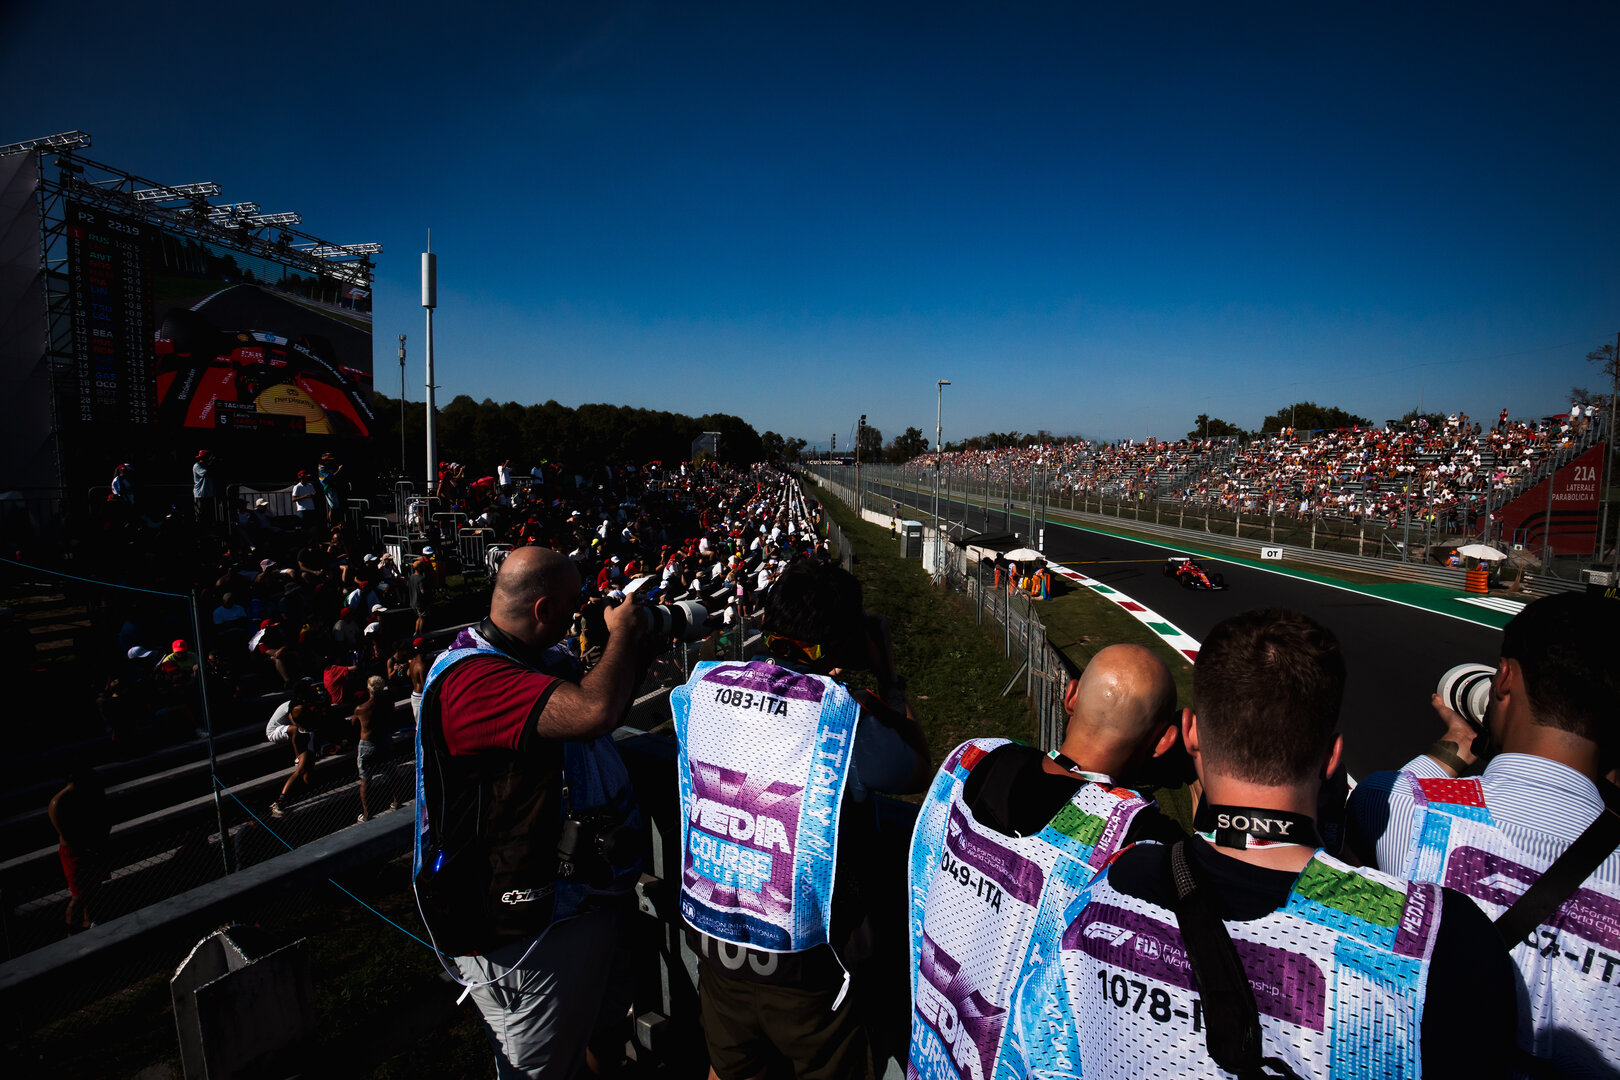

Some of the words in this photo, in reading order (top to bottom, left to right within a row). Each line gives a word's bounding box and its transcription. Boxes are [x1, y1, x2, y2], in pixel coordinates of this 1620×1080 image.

[78, 212, 95, 223] P2
[108, 219, 140, 236] 22:19
[89, 233, 110, 244] RUS
[89, 252, 112, 262] ANT
[93, 329, 113, 338] BEA
[220, 416, 226, 424] 5
[1574, 466, 1596, 481] 21A
[1552, 493, 1589, 501] PARABOLICA
[1566, 484, 1595, 492] LATERALE
[714, 688, 788, 716] 1083-ITA
[806, 724, 848, 826] ITALY
[690, 792, 792, 854] MEDIA
[1217, 814, 1294, 835] SONY
[690, 830, 770, 880] COURSE
[942, 851, 1002, 914] 049-ITA
[1163, 944, 1181, 958] FIA
[1098, 969, 1202, 1032] 1078-I
[916, 971, 985, 1080] EDIA
